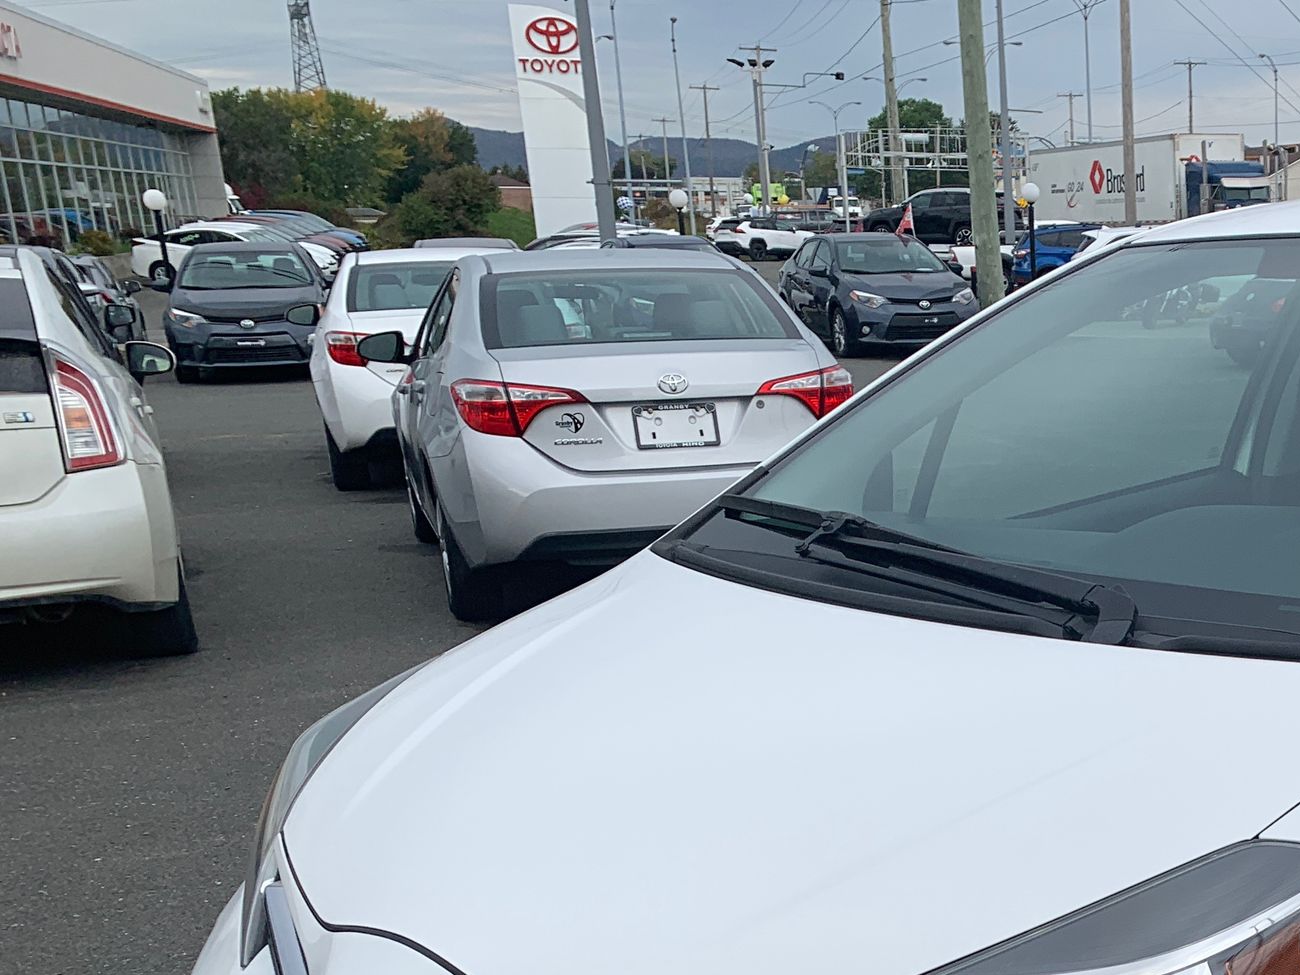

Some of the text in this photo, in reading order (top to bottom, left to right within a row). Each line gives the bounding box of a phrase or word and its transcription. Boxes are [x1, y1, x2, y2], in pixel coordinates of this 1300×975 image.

[518, 58, 583, 74] TOYOT
[1106, 165, 1145, 194] Brosrd
[554, 438, 603, 446] COROLLA
